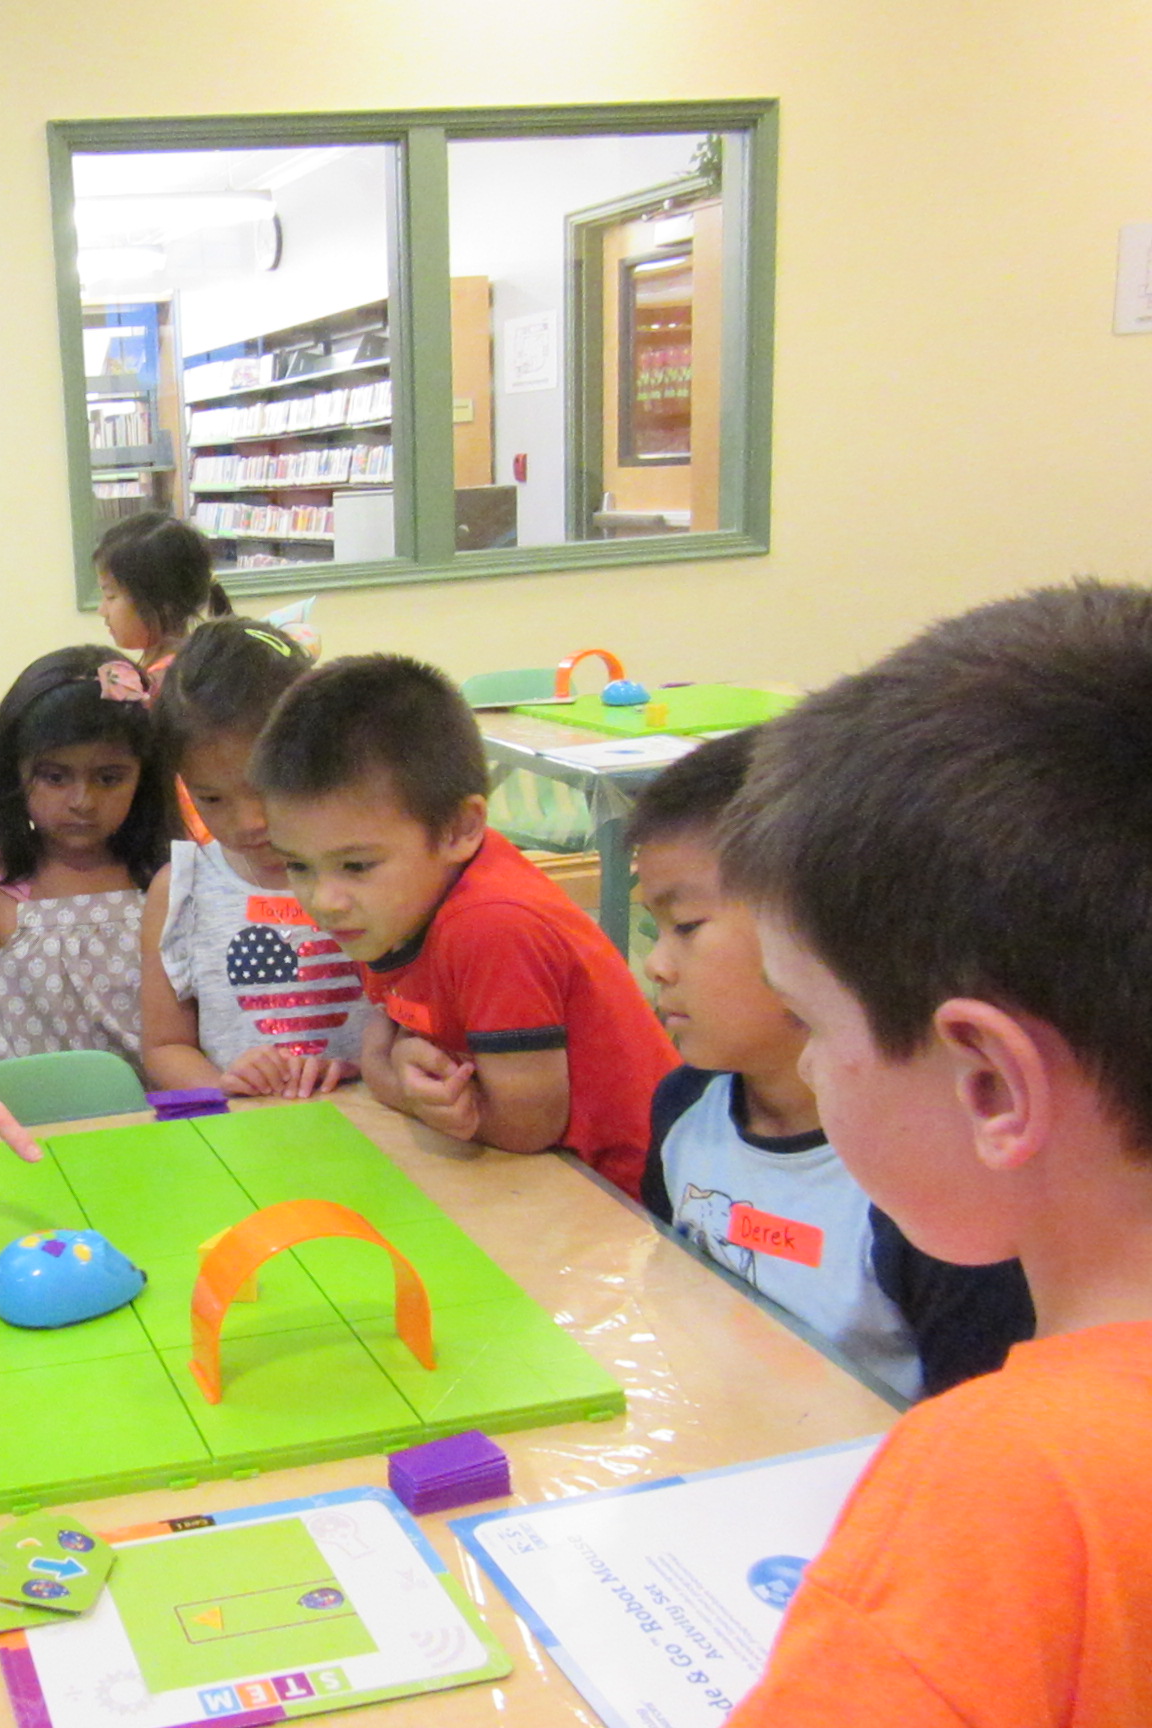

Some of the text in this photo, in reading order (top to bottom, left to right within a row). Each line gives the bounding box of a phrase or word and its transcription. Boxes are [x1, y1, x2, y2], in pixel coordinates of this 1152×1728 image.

[741, 1216, 795, 1250] Derek
[567, 1535, 619, 1583] Mouse
[611, 1585, 663, 1633] Robot
[644, 1584, 671, 1605] Set
[665, 1605, 724, 1659] Activity
[204, 1671, 341, 1712] STEM
[687, 1670, 709, 1683] &
